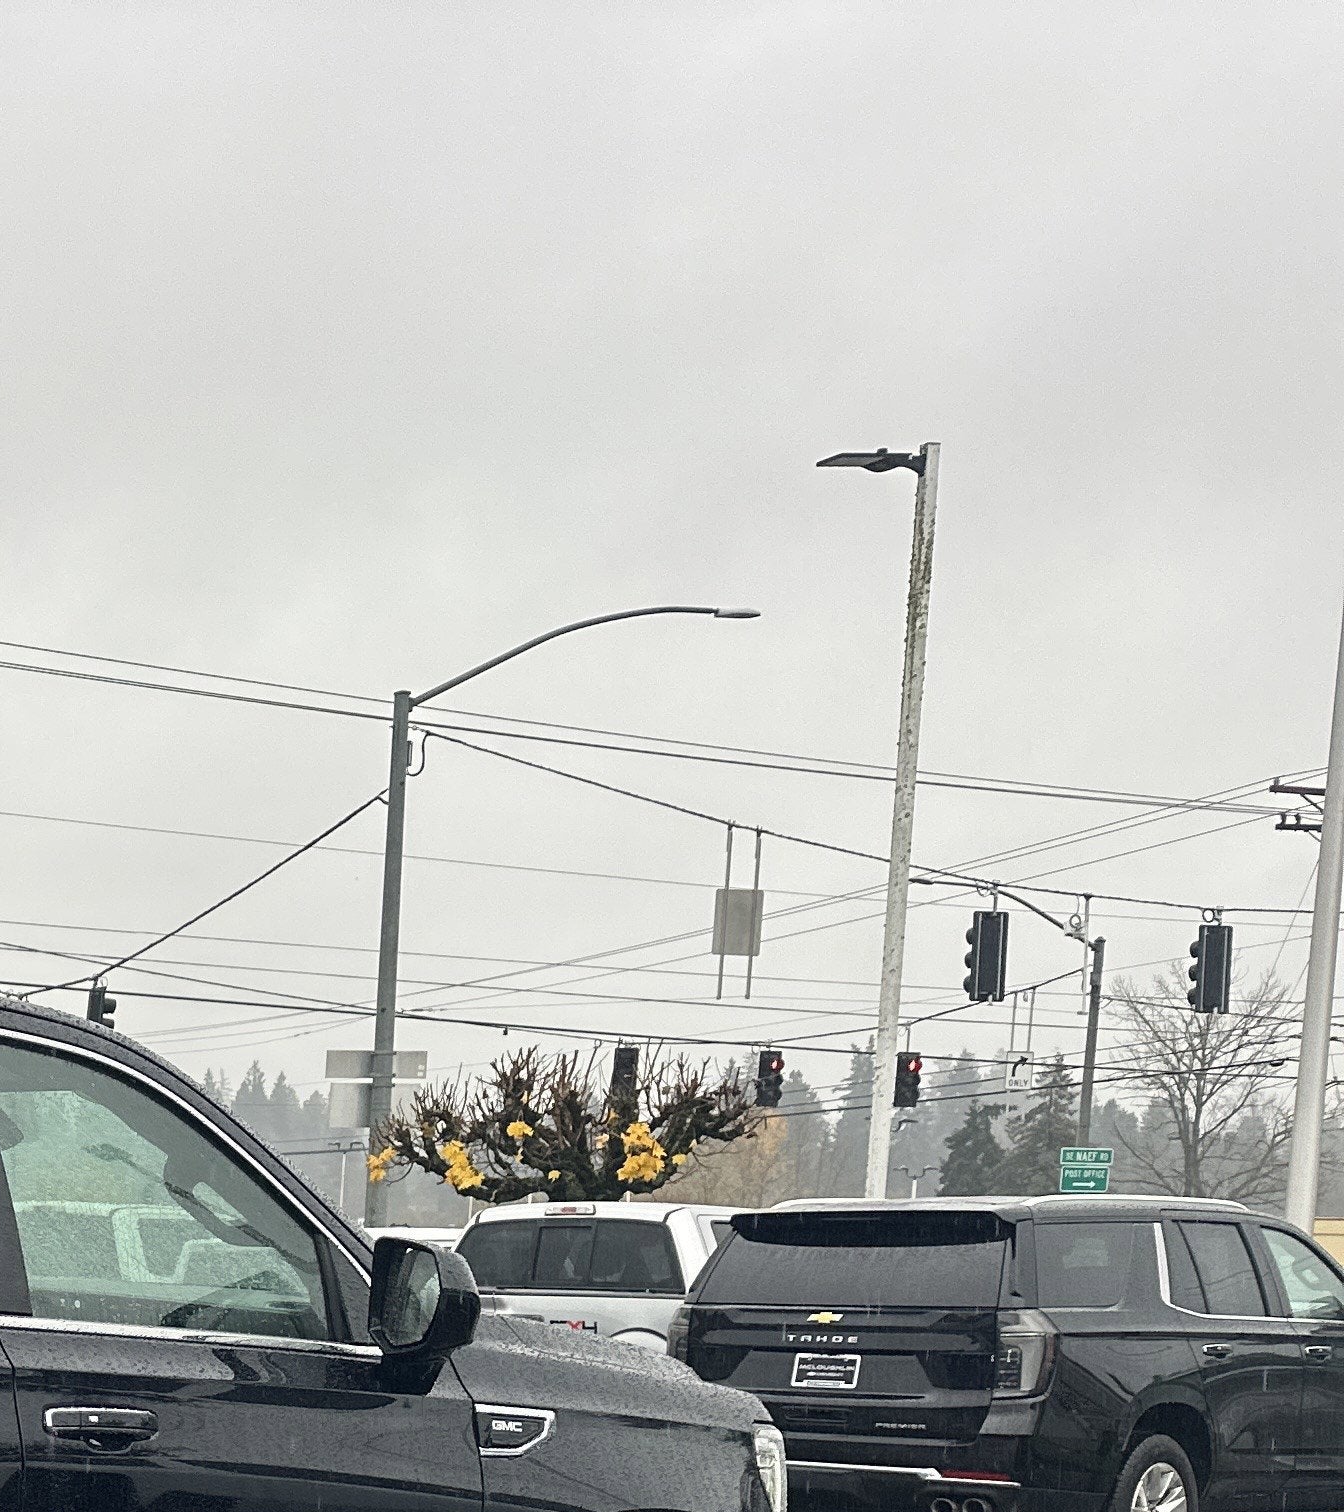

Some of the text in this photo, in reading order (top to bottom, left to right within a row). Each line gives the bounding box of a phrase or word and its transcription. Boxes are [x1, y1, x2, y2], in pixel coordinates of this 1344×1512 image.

[1008, 1079, 1028, 1087] ONLY
[1076, 1152, 1098, 1161] NAEF
[1064, 1169, 1105, 1178] POST OFFICE
[787, 1334, 858, 1343] TAHOE
[491, 1419, 523, 1432] GMC
